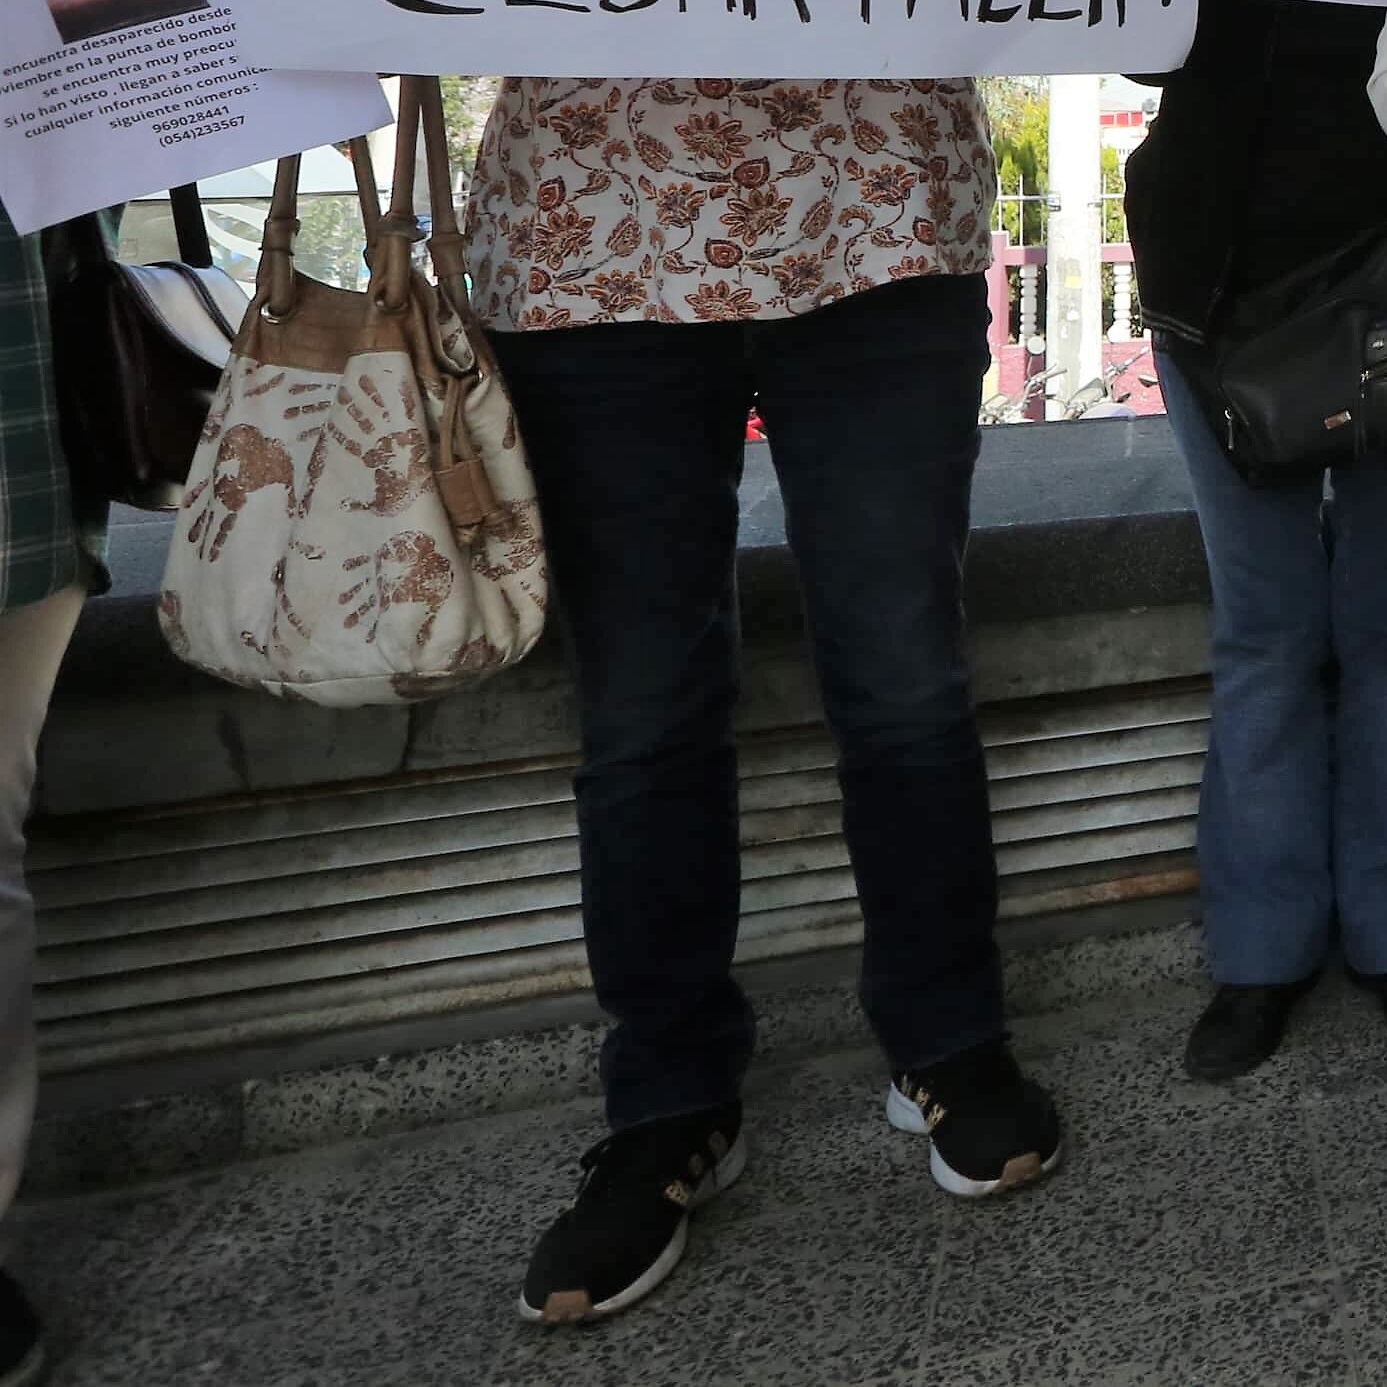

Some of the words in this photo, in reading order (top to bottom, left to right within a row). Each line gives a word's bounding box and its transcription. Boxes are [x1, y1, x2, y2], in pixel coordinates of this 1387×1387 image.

[0, 69, 62, 94] viembre
[66, 62, 85, 73] en
[87, 57, 103, 67] la
[106, 44, 153, 64] punta
[156, 38, 176, 49] de
[3, 47, 78, 76] encuentra
[81, 19, 184, 52] desaparecido
[188, 8, 232, 24] desde
[42, 87, 58, 98] se
[62, 64, 142, 91] encuentra
[145, 53, 179, 69] muy
[183, 37, 237, 62] preocu
[20, 112, 36, 122] lo
[38, 102, 68, 117] han
[69, 90, 108, 106] visto
[118, 74, 168, 92] llegan
[170, 70, 181, 79] a
[183, 58, 225, 76] saber
[25, 110, 94, 138] cualquier
[98, 84, 193, 115] información
[109, 104, 181, 129] siguiente
[184, 85, 250, 108] números
[152, 105, 230, 134] 969028441
[159, 115, 245, 148] (054)233567
